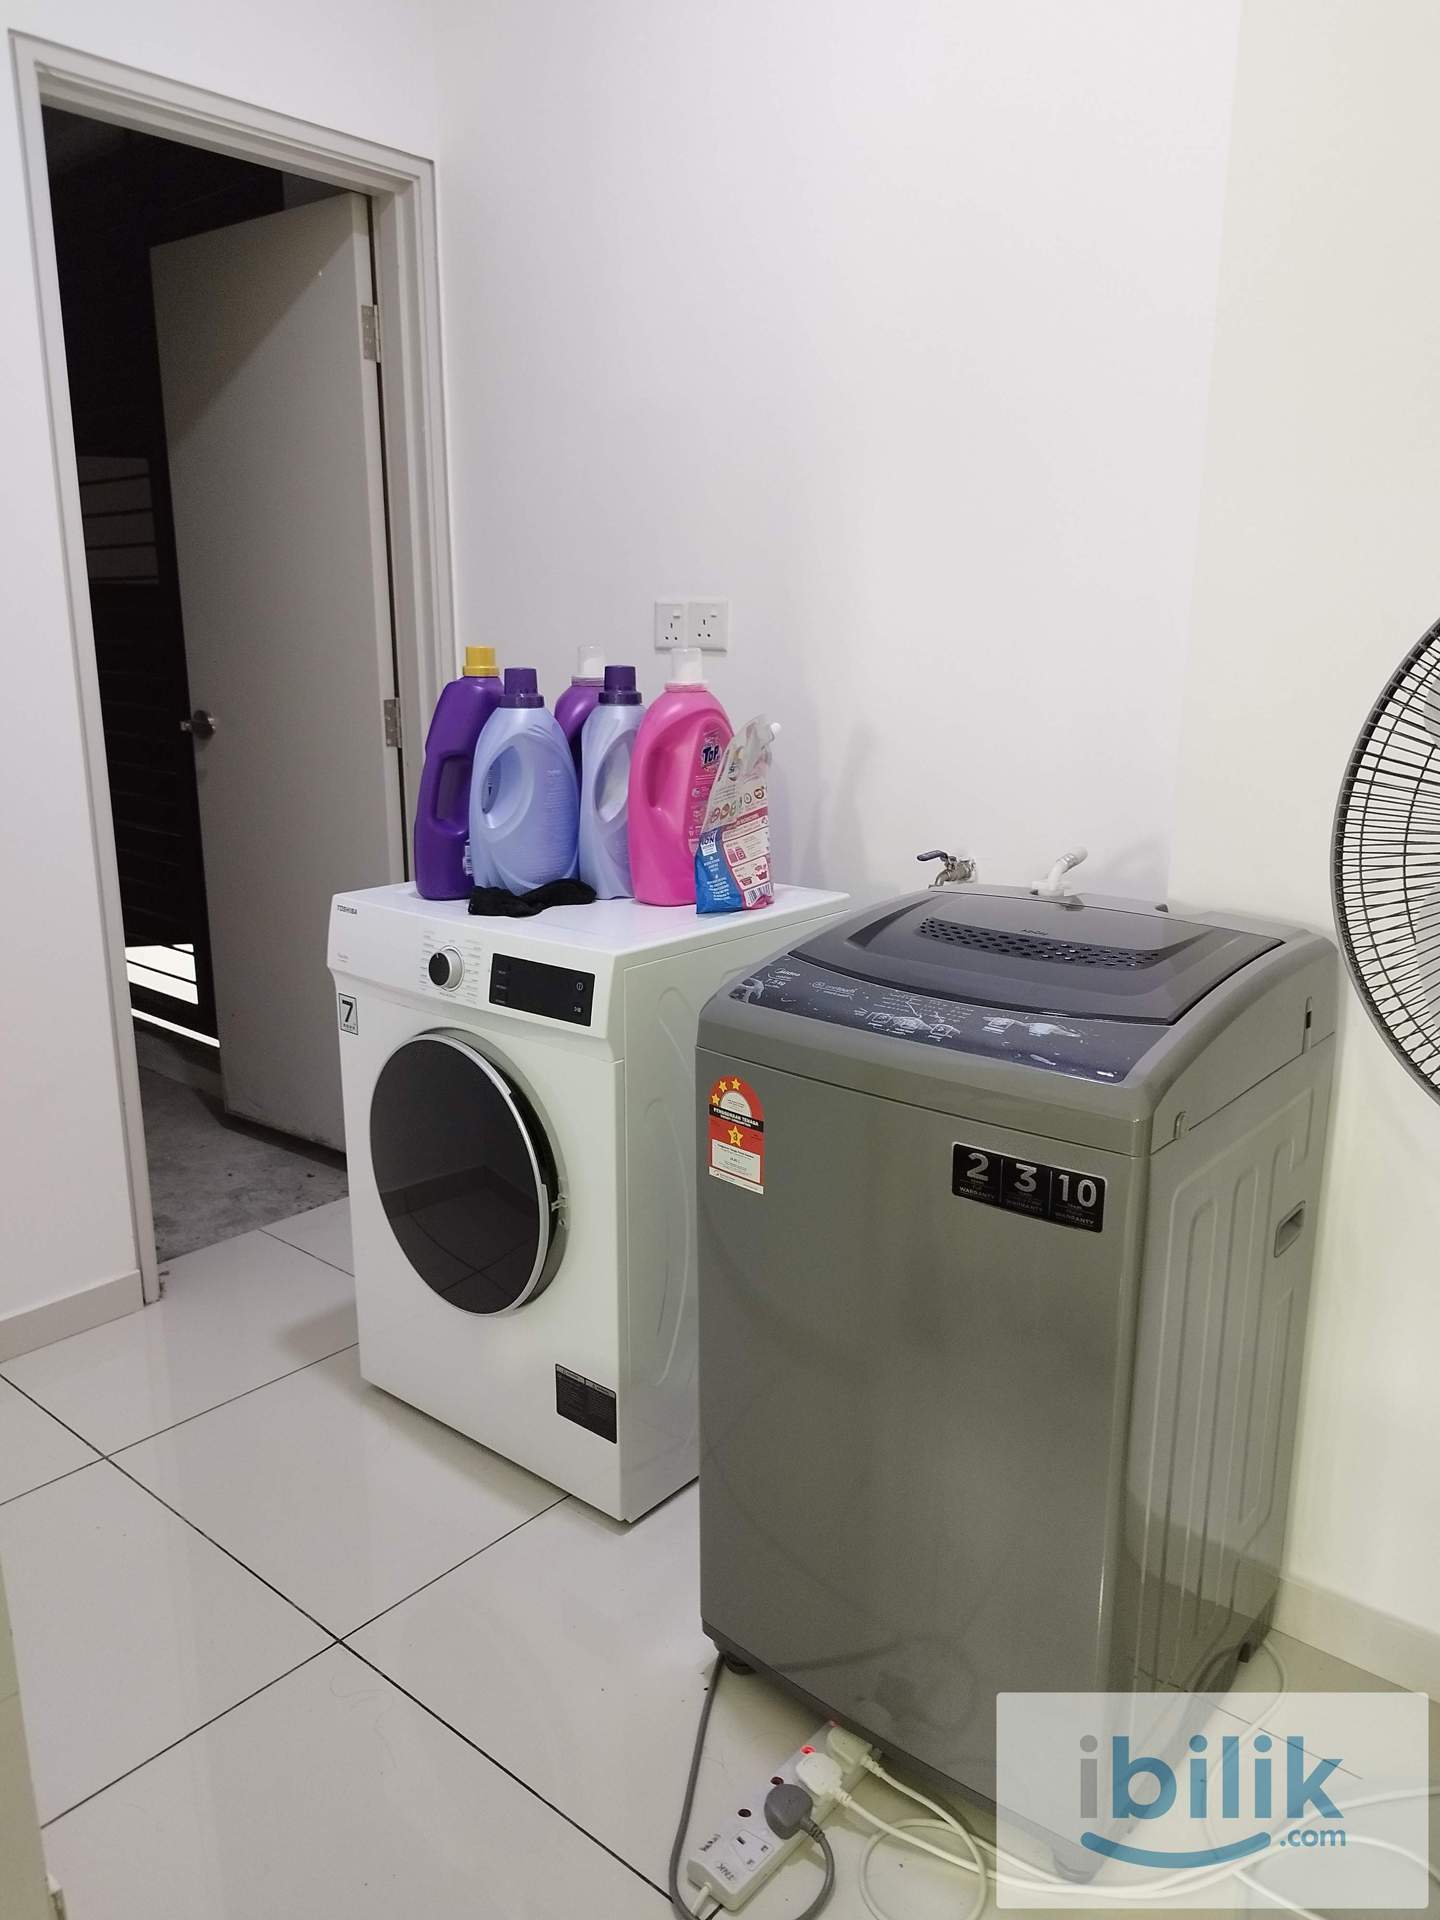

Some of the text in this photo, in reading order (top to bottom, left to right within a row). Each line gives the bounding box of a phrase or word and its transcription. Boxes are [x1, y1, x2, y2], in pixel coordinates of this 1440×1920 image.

[337, 904, 358, 915] TOSHIBA
[732, 1132, 738, 1141] 3
[966, 1152, 989, 1182] 2
[1014, 1163, 1037, 1192] 3
[1058, 1174, 1097, 1208] 10
